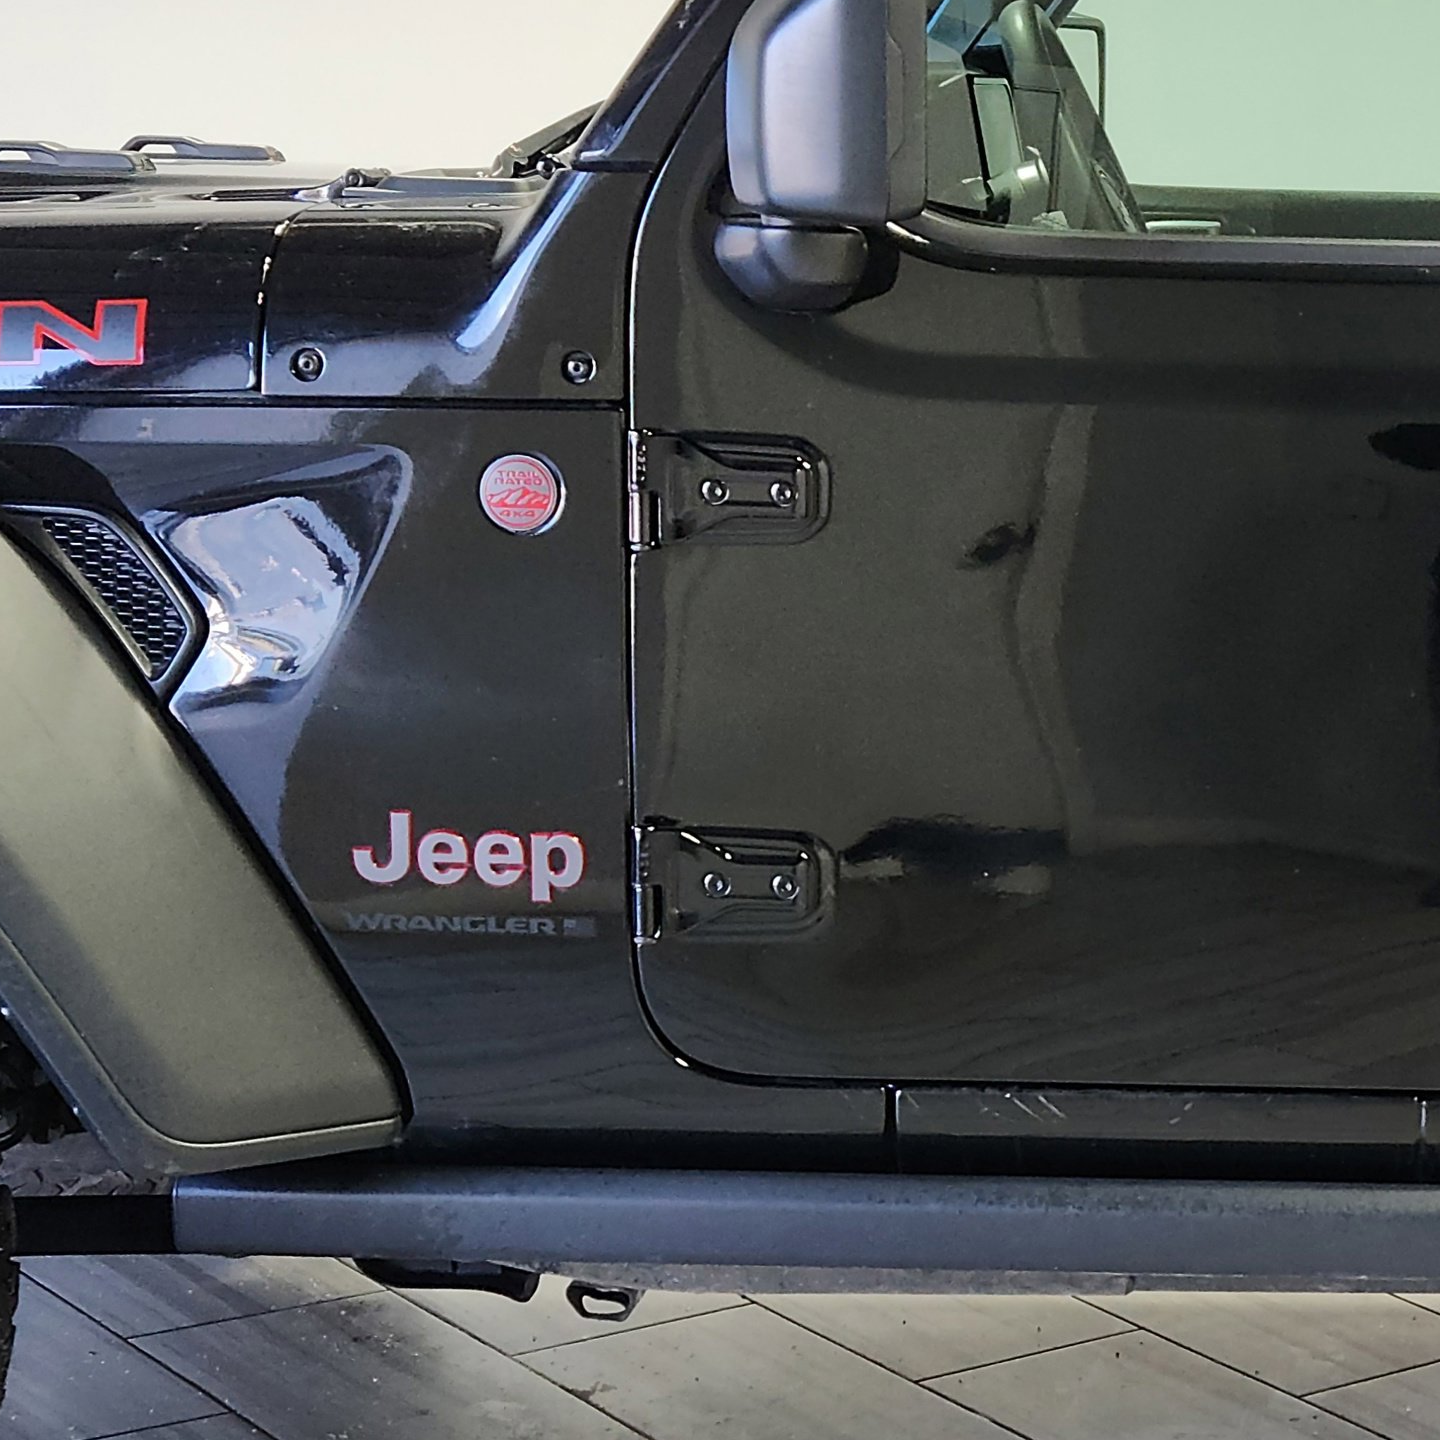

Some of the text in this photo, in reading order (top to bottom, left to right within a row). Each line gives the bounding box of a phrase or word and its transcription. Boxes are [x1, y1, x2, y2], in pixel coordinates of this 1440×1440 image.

[494, 477, 543, 487] RATED
[497, 470, 539, 479] TRAIL
[352, 808, 587, 903] Jeep
[343, 912, 557, 934] WRANGLER
